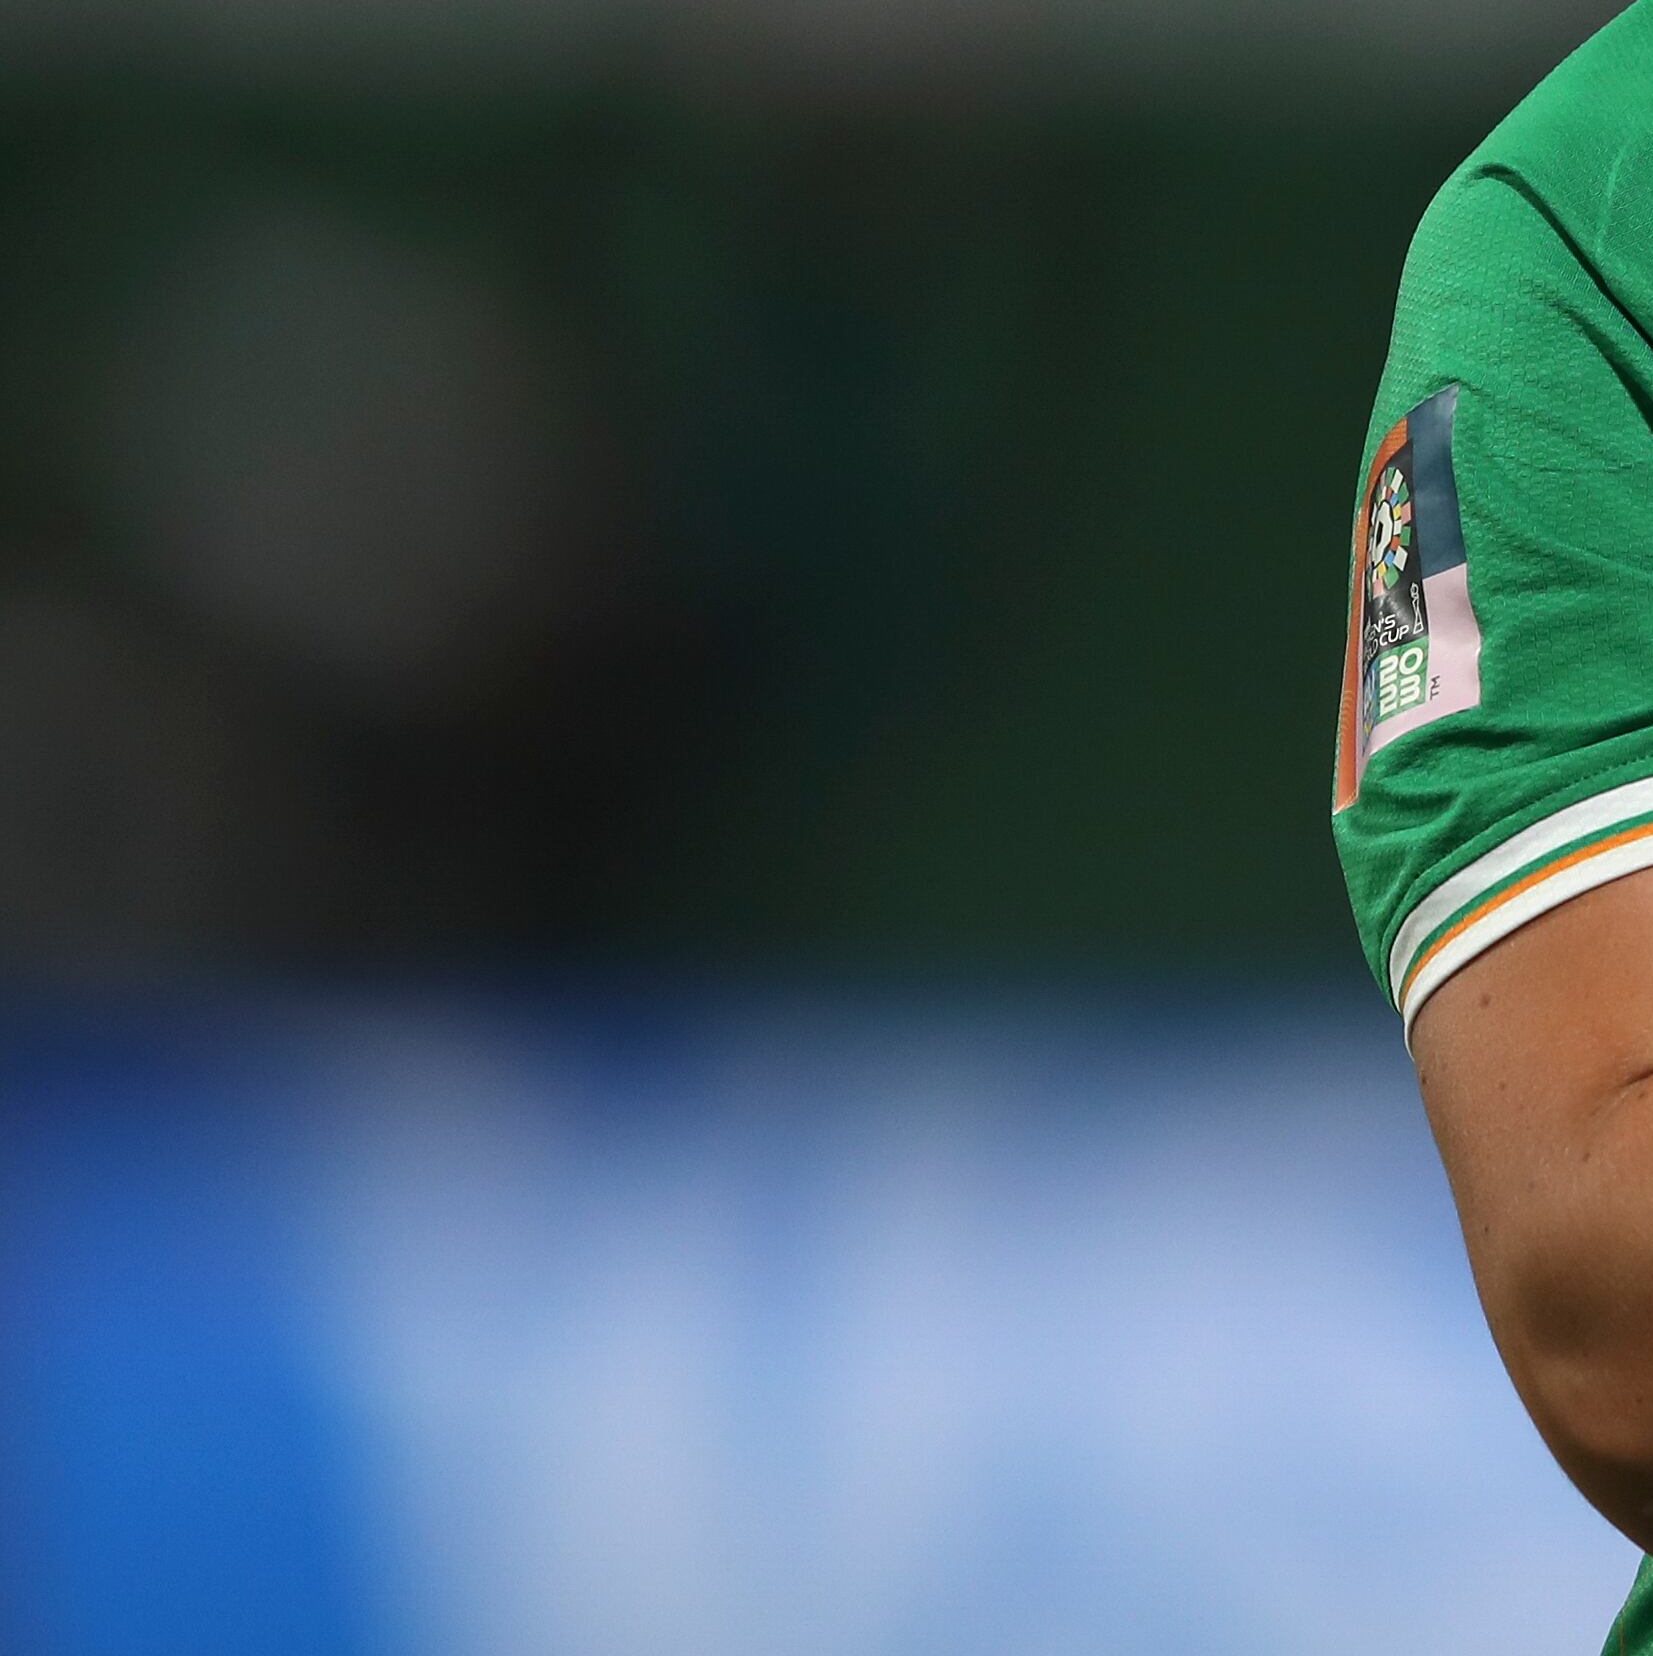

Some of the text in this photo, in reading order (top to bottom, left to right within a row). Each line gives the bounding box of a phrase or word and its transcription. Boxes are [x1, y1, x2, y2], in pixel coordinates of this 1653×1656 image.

[1379, 625, 1410, 646] CUP
[1379, 647, 1424, 685] 20
[1379, 674, 1421, 717] 23
[1429, 675, 1441, 701] TM
